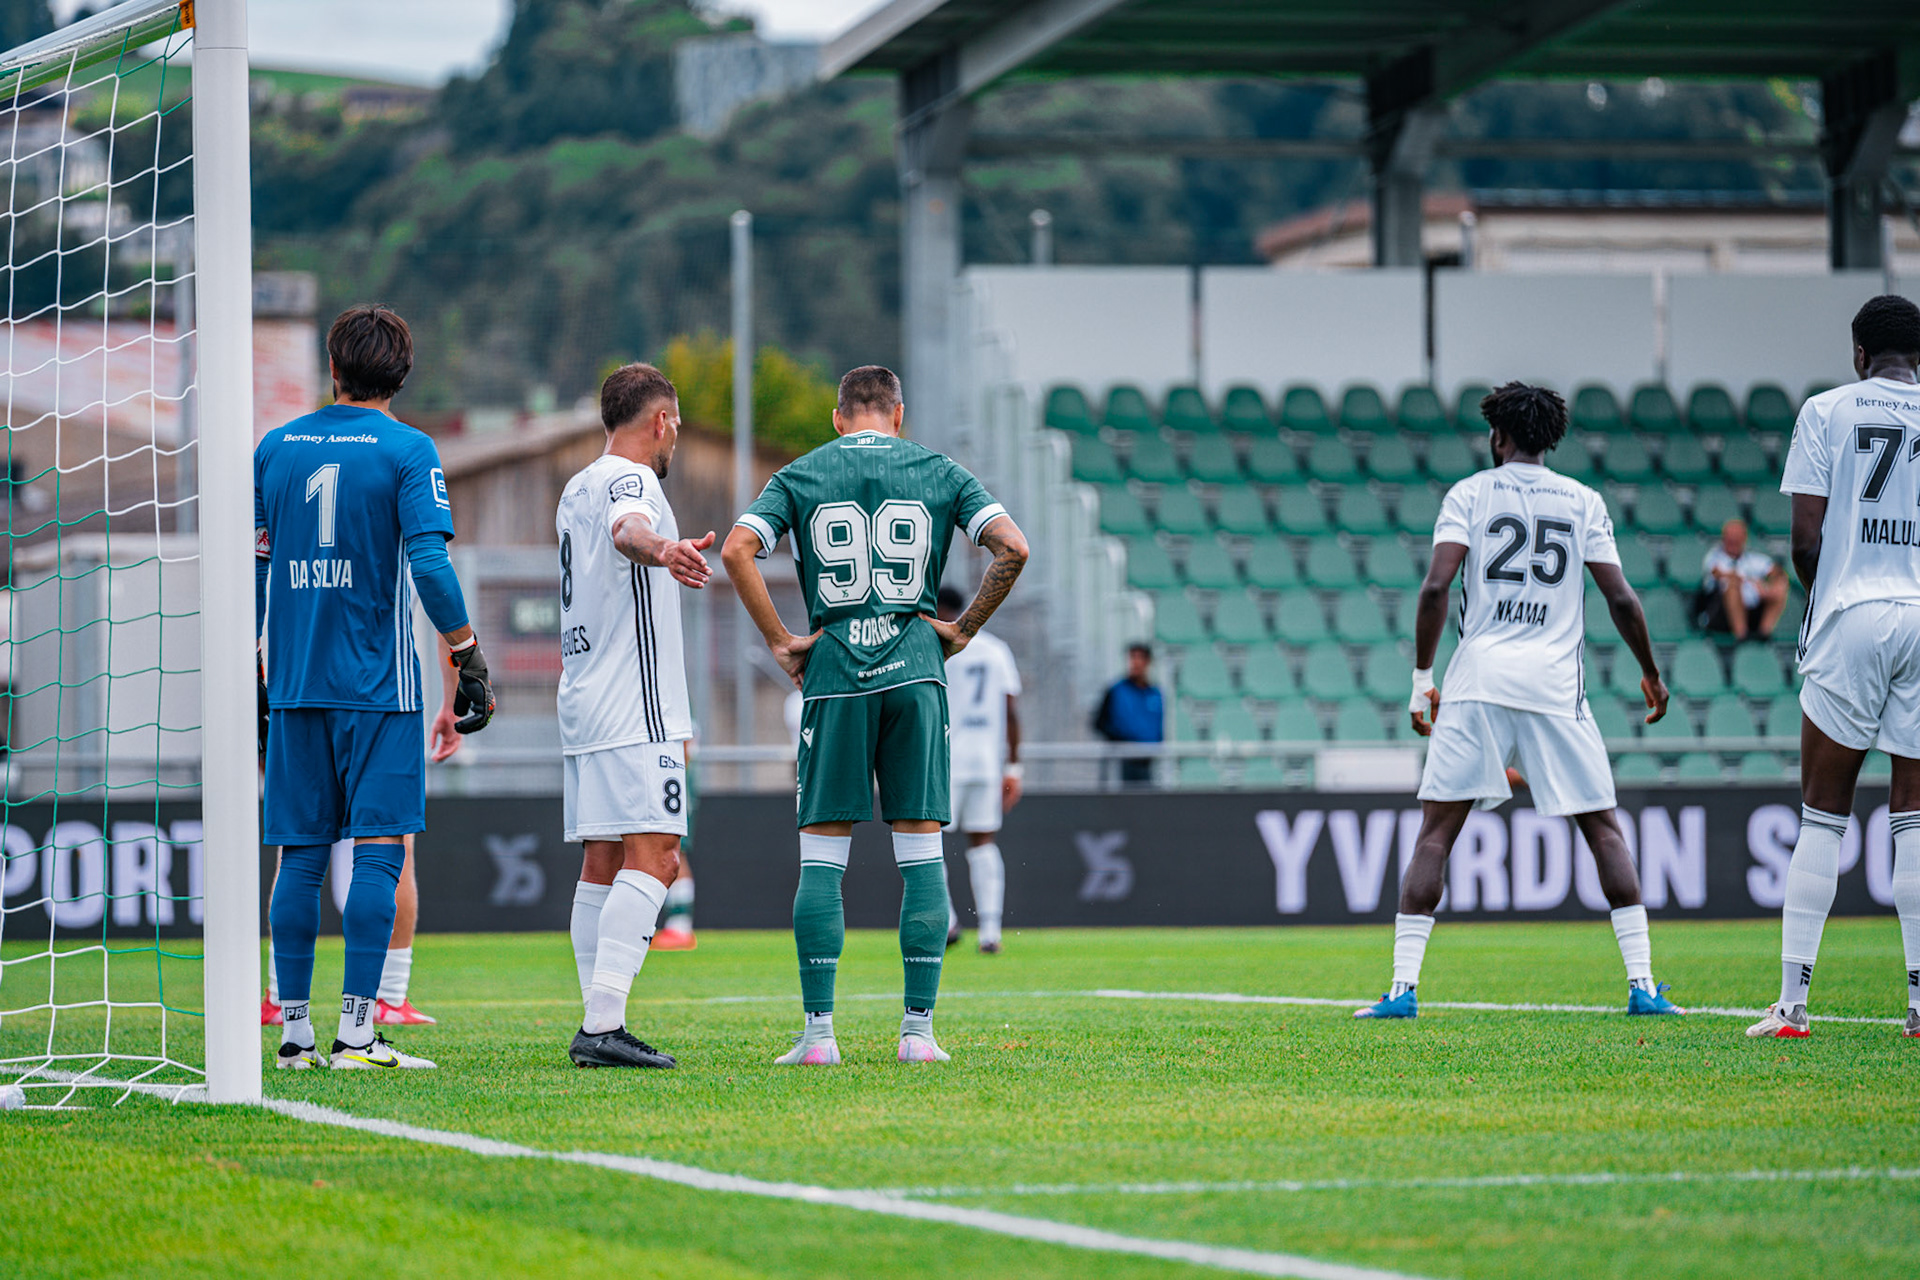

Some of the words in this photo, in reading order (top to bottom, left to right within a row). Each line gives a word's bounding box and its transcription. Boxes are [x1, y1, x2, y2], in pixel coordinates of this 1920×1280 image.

[1856, 397, 1900, 411] Berney
[283, 434, 325, 444] Berney
[326, 434, 378, 443] Associés
[857, 436, 875, 445] 1897
[615, 481, 638, 494] SP
[305, 463, 340, 547] 1
[1861, 518, 1920, 547] MALUL
[809, 499, 933, 608] 99
[1483, 512, 1575, 588] 25
[289, 560, 309, 589] DA
[312, 559, 352, 589] SILVA
[559, 529, 573, 612] 8
[1493, 600, 1547, 626] NKAMA
[965, 663, 988, 704] 7
[663, 778, 682, 816] 8
